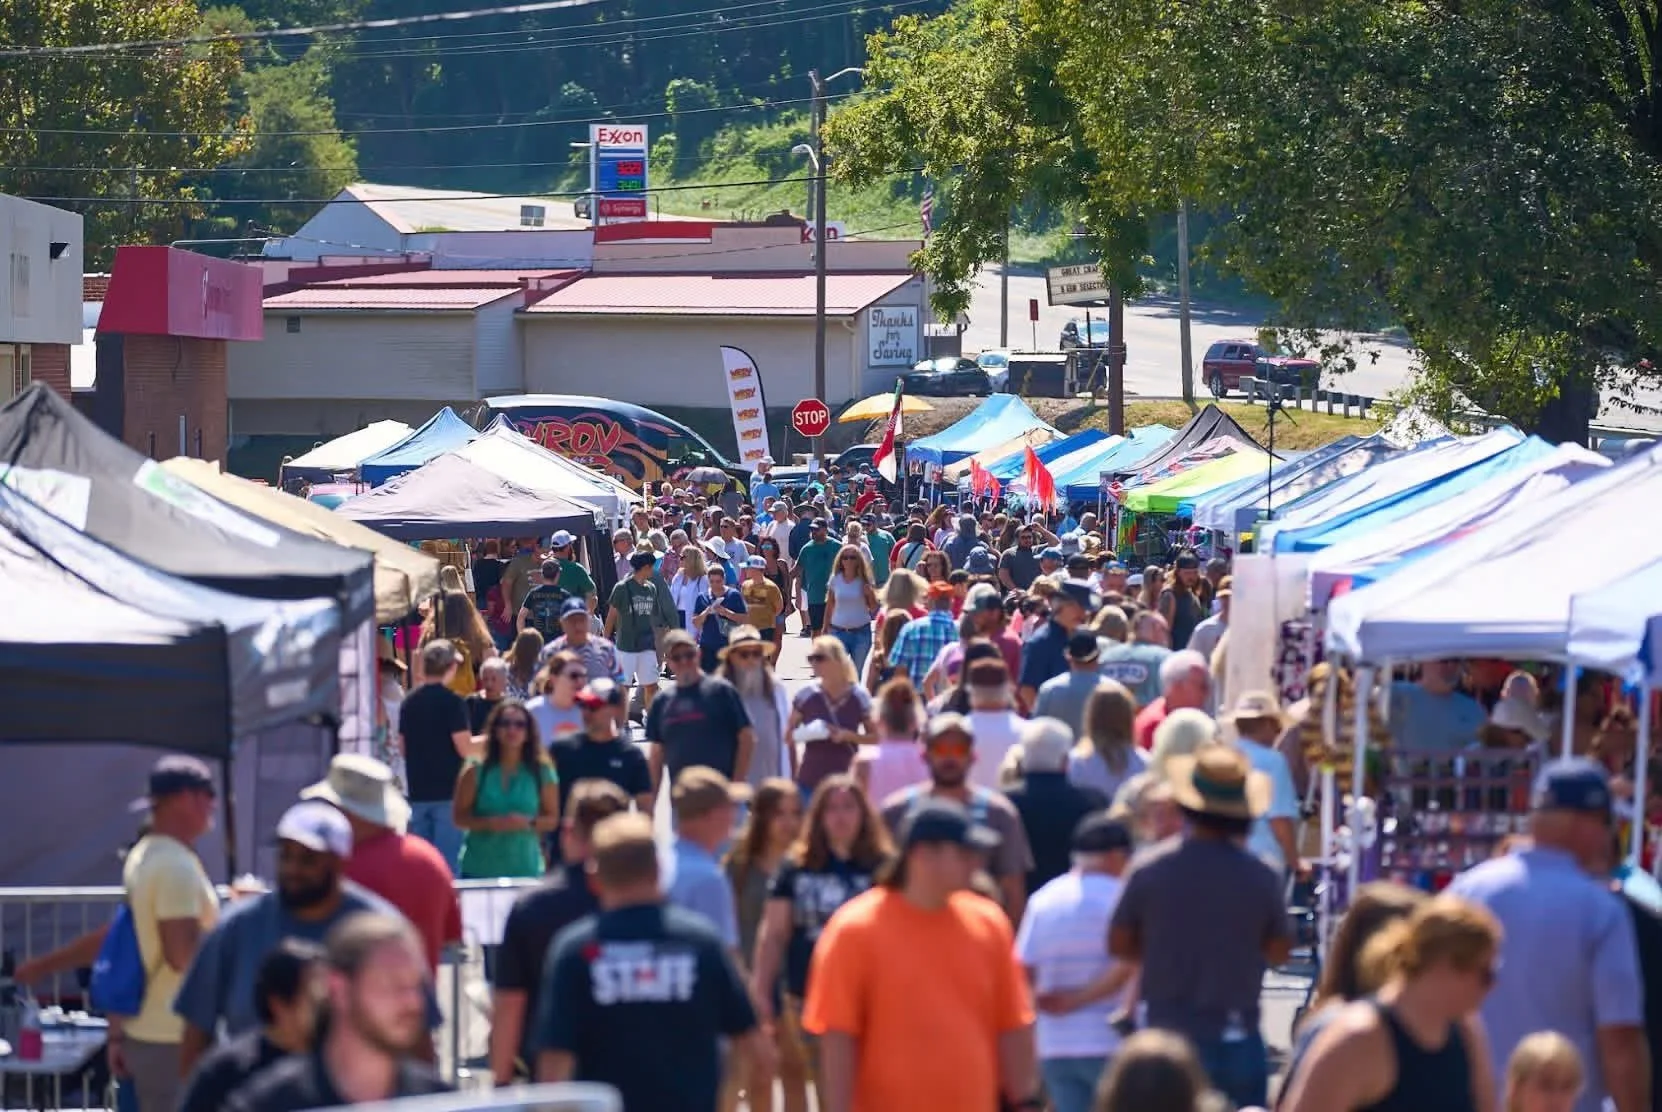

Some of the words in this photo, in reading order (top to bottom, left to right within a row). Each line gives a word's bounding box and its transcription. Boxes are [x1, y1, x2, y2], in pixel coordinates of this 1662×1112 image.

[598, 128, 643, 144] Exxon
[872, 309, 913, 327] Thanks
[886, 327, 900, 344] for
[873, 340, 912, 364] Saving
[796, 410, 826, 425] STOP
[593, 954, 697, 1006] STAFF
